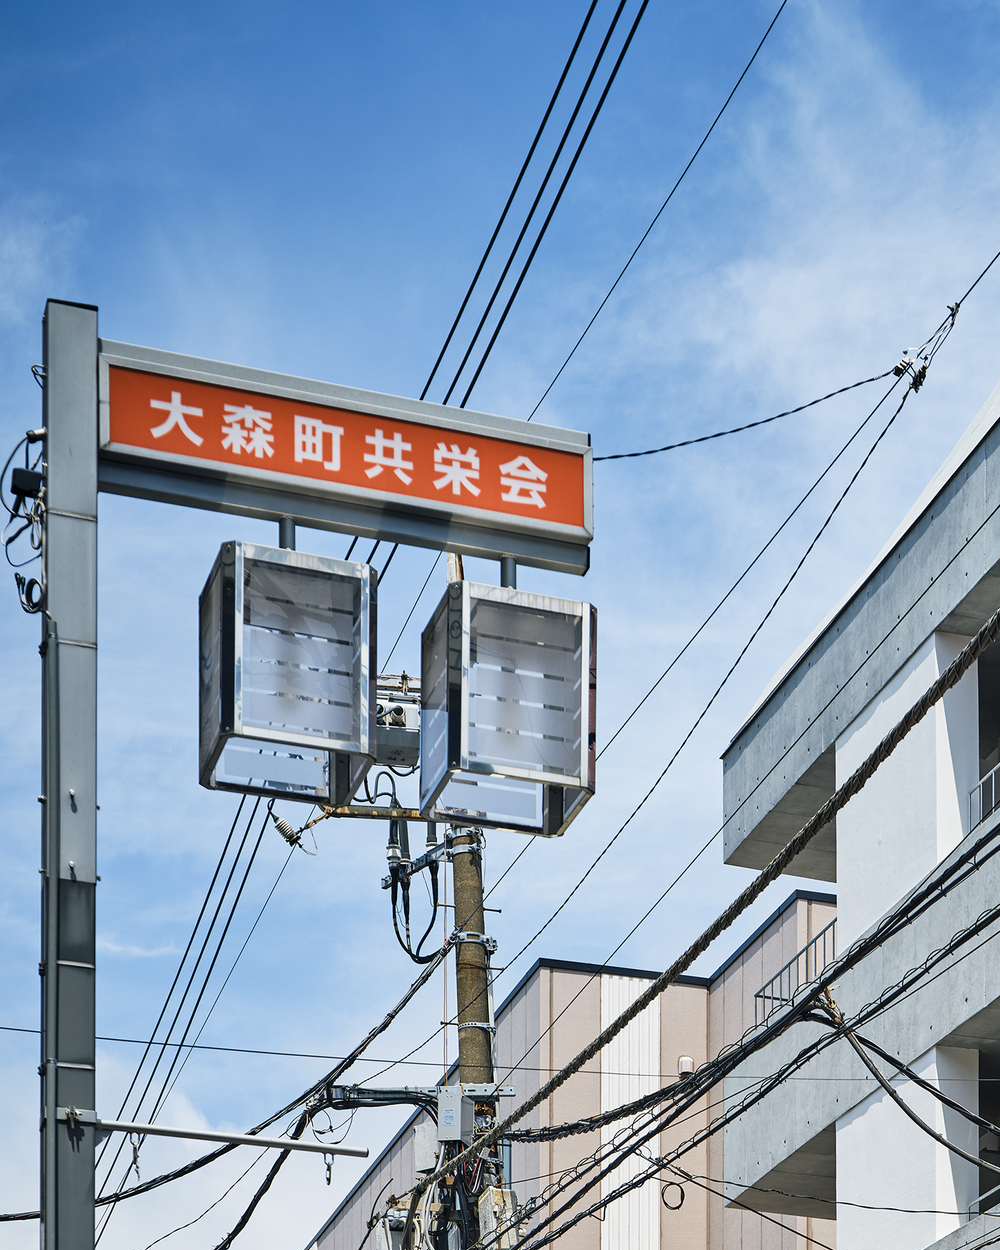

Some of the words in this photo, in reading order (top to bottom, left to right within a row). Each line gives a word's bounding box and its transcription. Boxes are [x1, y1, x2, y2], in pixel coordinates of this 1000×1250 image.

[149, 391, 549, 509] 大森町共栄会
